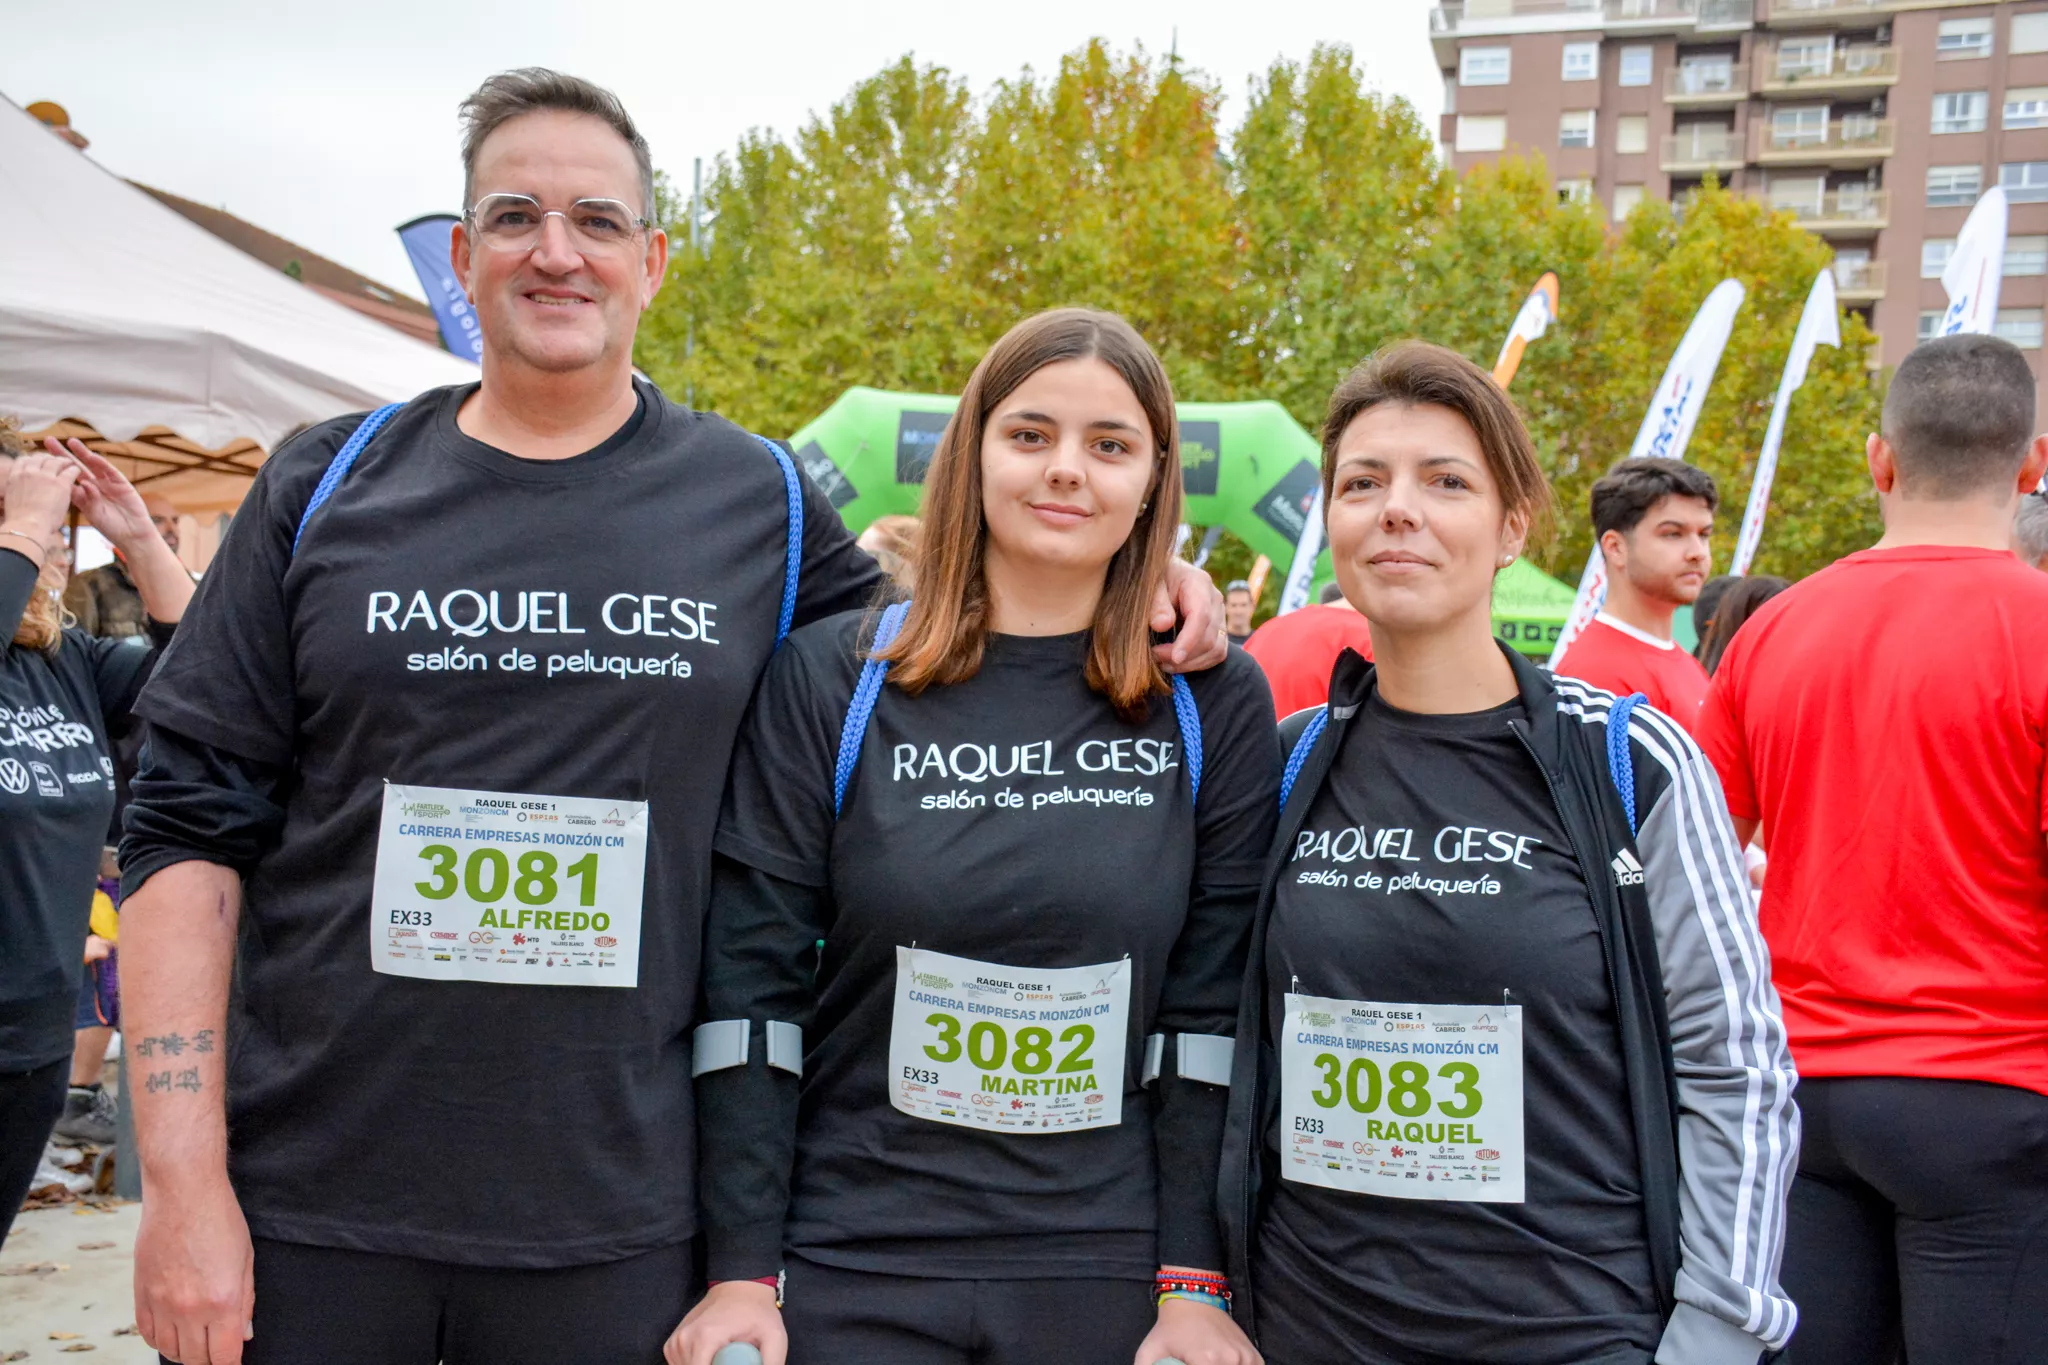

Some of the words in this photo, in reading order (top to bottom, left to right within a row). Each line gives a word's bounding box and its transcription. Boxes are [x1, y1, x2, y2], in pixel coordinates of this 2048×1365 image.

[366, 588, 586, 638] RAQUEL
[601, 592, 720, 645] GESE
[406, 645, 488, 671] salón
[498, 647, 537, 672] de
[547, 648, 693, 680] peluquería
[892, 740, 1065, 783] RAQUEL
[1076, 738, 1179, 776] GESE
[475, 798, 518, 809] RAQUEL
[520, 801, 548, 811] GESE
[550, 803, 557, 811] 1
[920, 788, 986, 810] salón
[994, 787, 1025, 809] de
[1032, 785, 1155, 811] peluquería
[417, 810, 444, 819] SPORT
[529, 813, 559, 821] ESPIAS
[567, 818, 597, 826] CABRERO
[399, 823, 462, 839] CARRERA
[465, 828, 540, 844] EMPRESAS
[543, 832, 602, 846] MONZÓN
[605, 836, 625, 848] CM
[1291, 824, 1422, 864] RAQUEL
[1434, 825, 1542, 870] GESE
[414, 844, 599, 907] 3081
[1296, 869, 1348, 888] salón
[1354, 870, 1382, 889] de
[1387, 872, 1501, 896] peluquería
[390, 909, 432, 927] EX33
[478, 908, 611, 932] ALFREDO
[924, 979, 948, 991] SPORT
[976, 976, 1015, 990] RAQUEL
[1017, 982, 1044, 991] GESE
[1046, 984, 1052, 992] 1
[908, 990, 965, 1011] CARRERA
[967, 1002, 1036, 1021] EMPRESAS
[1040, 1005, 1092, 1021] MONZÓN
[1093, 1003, 1110, 1016] CM
[1061, 994, 1087, 1002] CABRERO
[1351, 1008, 1384, 1019] RAQUEL
[1386, 1011, 1413, 1020] GESE
[1416, 1012, 1422, 1020] 1
[922, 1013, 1096, 1075] 3082
[1297, 1032, 1344, 1048] CARRERA
[1346, 1038, 1409, 1054] EMPRESAS
[1412, 1040, 1474, 1055] MONZÓN
[1478, 1043, 1499, 1055] CM
[903, 1065, 939, 1085] EX33
[980, 1073, 1098, 1096] MARTINA
[1311, 1052, 1483, 1119] 3083
[1294, 1115, 1324, 1134] EX33
[1366, 1118, 1483, 1145] RAQUEL
